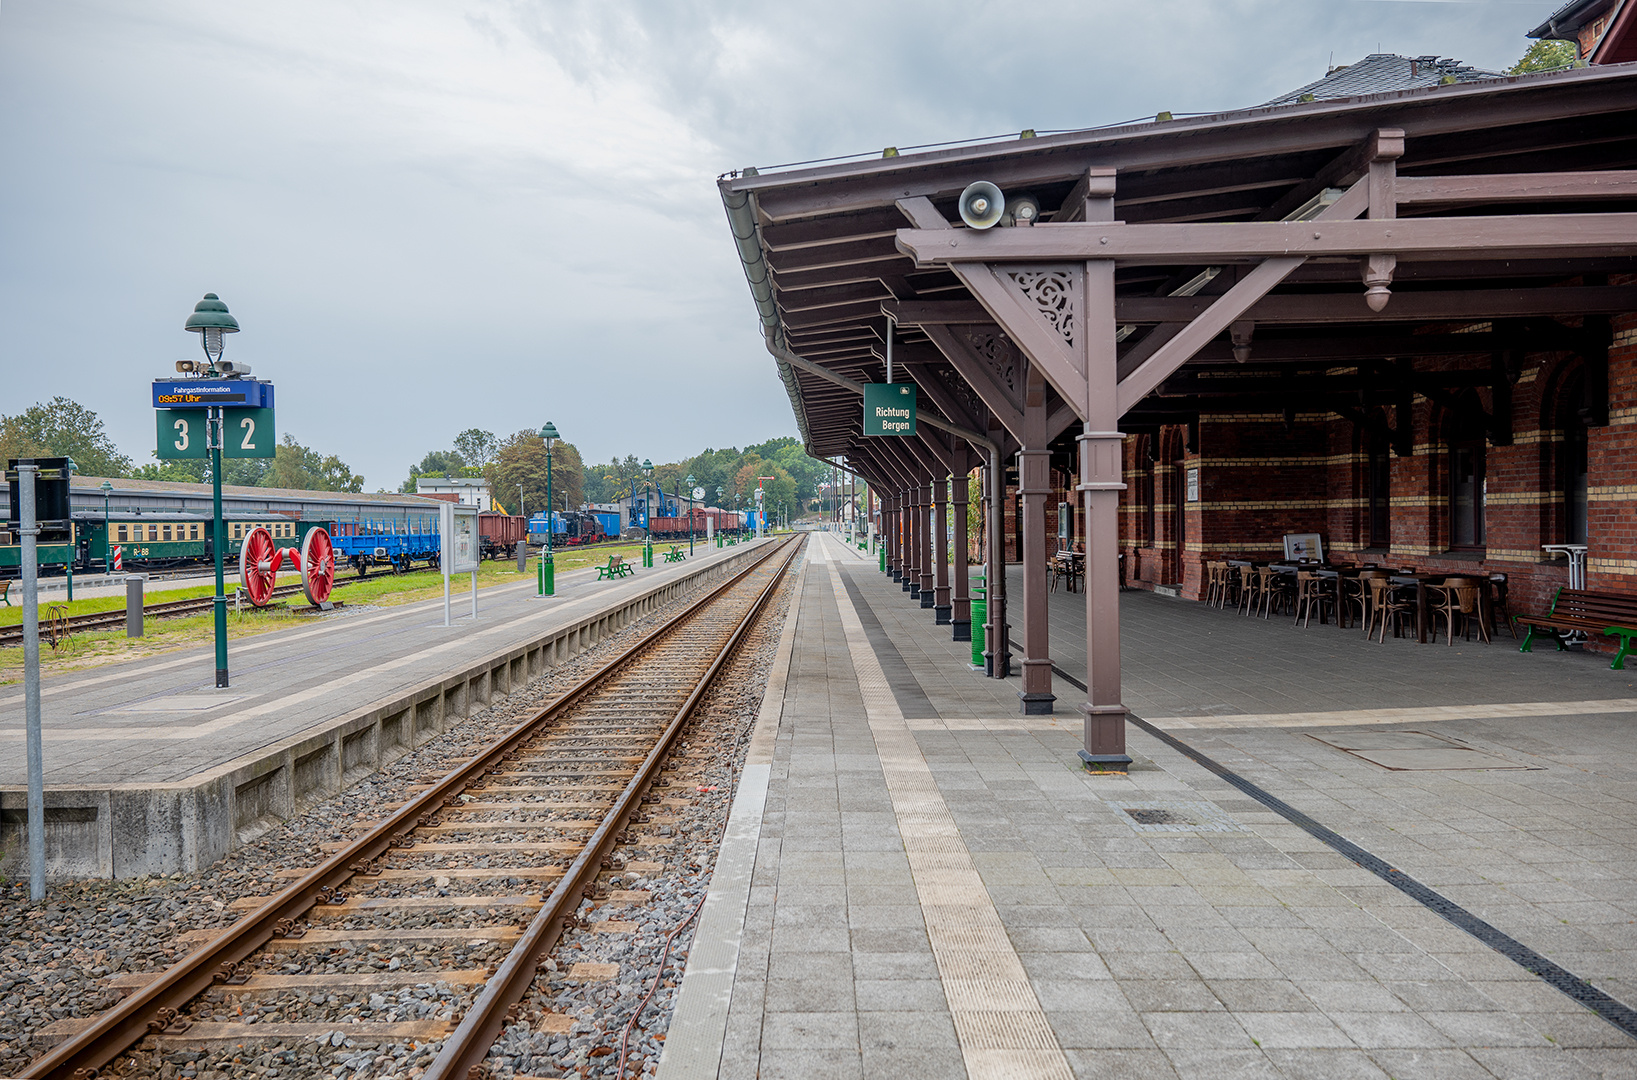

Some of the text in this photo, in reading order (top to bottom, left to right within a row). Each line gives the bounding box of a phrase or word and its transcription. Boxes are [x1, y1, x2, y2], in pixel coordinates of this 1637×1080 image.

[185, 394, 202, 402] Uhr
[875, 407, 910, 419] Richtung
[882, 420, 910, 432] Bergen
[174, 418, 189, 451] 3
[240, 417, 256, 449] 2
